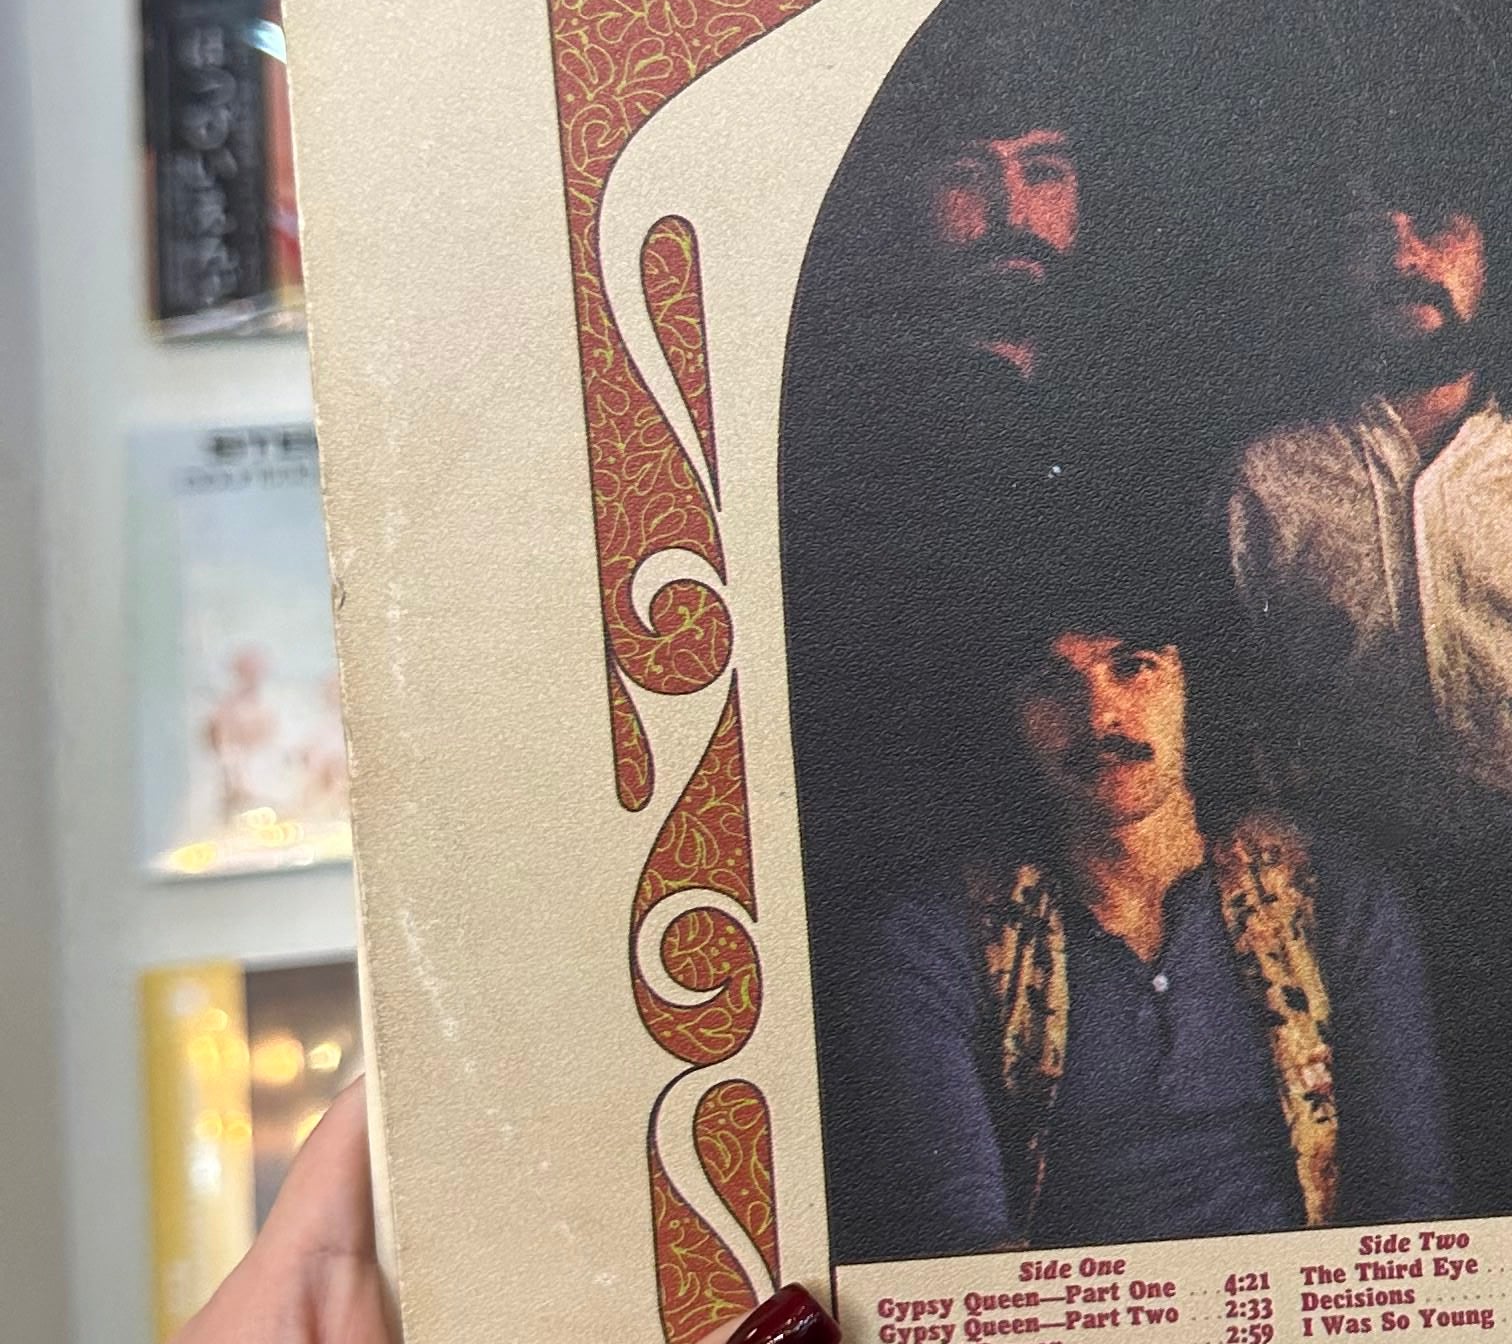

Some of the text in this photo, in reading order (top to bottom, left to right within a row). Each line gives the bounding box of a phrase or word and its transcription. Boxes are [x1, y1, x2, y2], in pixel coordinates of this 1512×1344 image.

[1360, 1232, 1471, 1256] Side Two
[1020, 1256, 1127, 1283] Side One
[1299, 1266, 1347, 1286] The
[1354, 1258, 1424, 1281] Third
[1432, 1257, 1480, 1280] Eye
[876, 1296, 955, 1324] Gypsy
[1128, 1279, 1177, 1300] One
[1223, 1271, 1271, 1296] 4:21
[1126, 1304, 1180, 1326] Two
[1226, 1296, 1274, 1321] 2:33
[1301, 1287, 1417, 1312] Decisions
[1303, 1316, 1314, 1338] I
[1321, 1313, 1373, 1336] Was
[1382, 1311, 1411, 1332] So
[1418, 1307, 1495, 1330] Young
